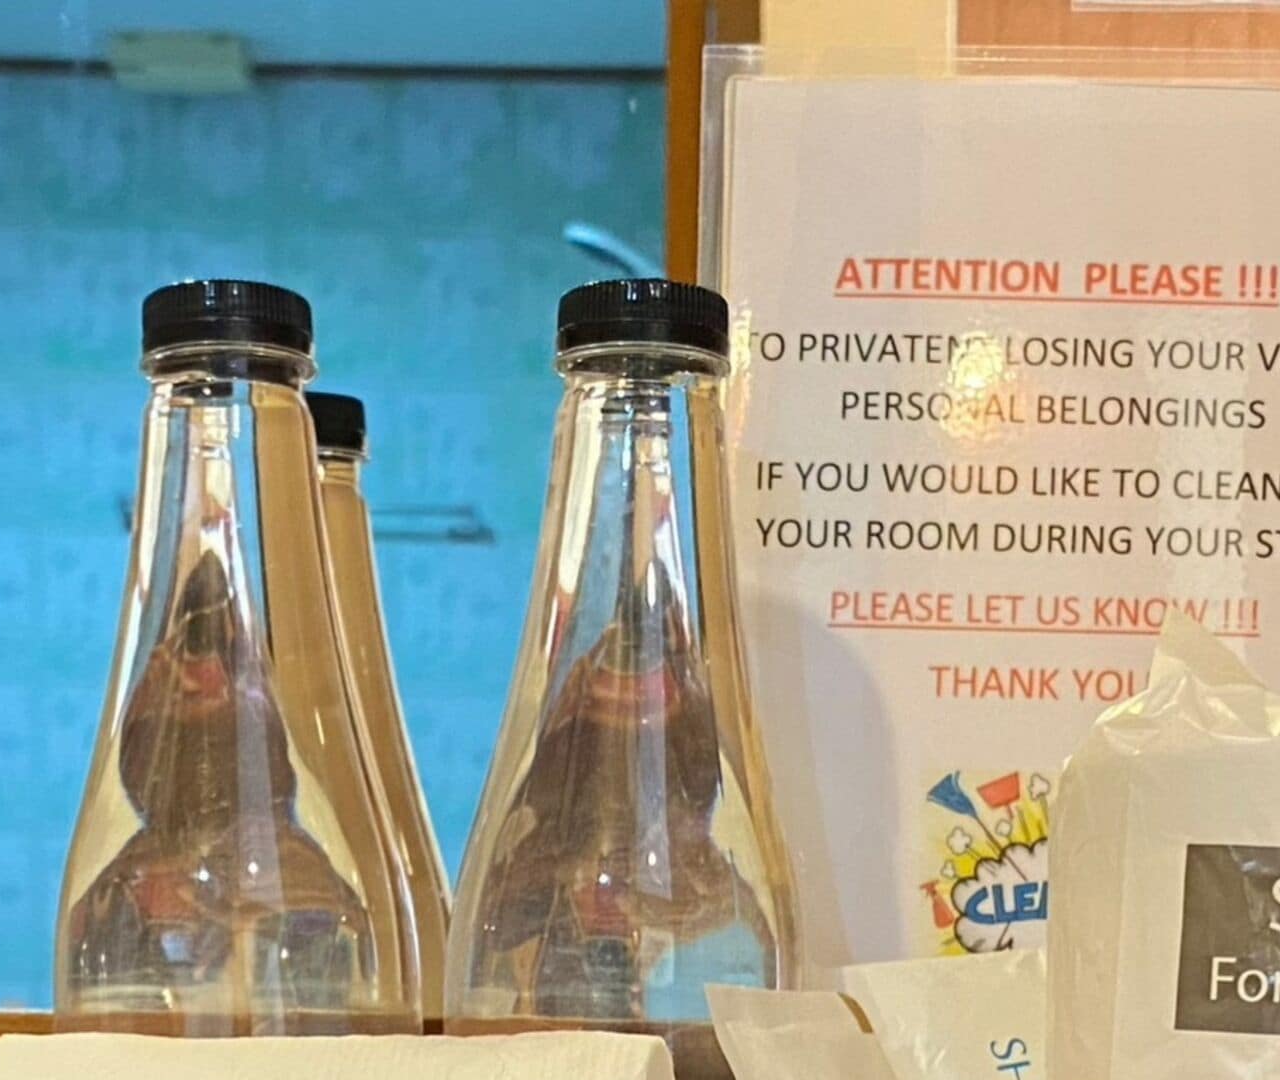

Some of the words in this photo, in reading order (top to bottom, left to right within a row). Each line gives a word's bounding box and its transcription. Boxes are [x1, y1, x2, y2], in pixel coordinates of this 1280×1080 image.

[834, 258, 1061, 293] ATTENTION
[1084, 263, 1222, 298] PLEASE
[1237, 265, 1280, 299] !!!
[1005, 337, 1134, 369] LOSING
[1148, 340, 1247, 372] YOUR
[1036, 395, 1267, 430] BELONGINGS
[756, 461, 784, 492] IF
[795, 462, 869, 494] YOU
[882, 463, 1019, 496] WOULD
[1031, 467, 1100, 498] LIKE
[1114, 469, 1161, 500] TO
[755, 518, 853, 550] YOUR
[867, 520, 980, 553] ROOM
[993, 523, 1133, 556] DURING
[1146, 526, 1245, 559] YOUR
[832, 591, 954, 625] PLEASE
[967, 595, 1022, 626] LET
[1036, 596, 1081, 627] US
[1223, 600, 1260, 631] !!!
[929, 666, 1061, 700] THANK
